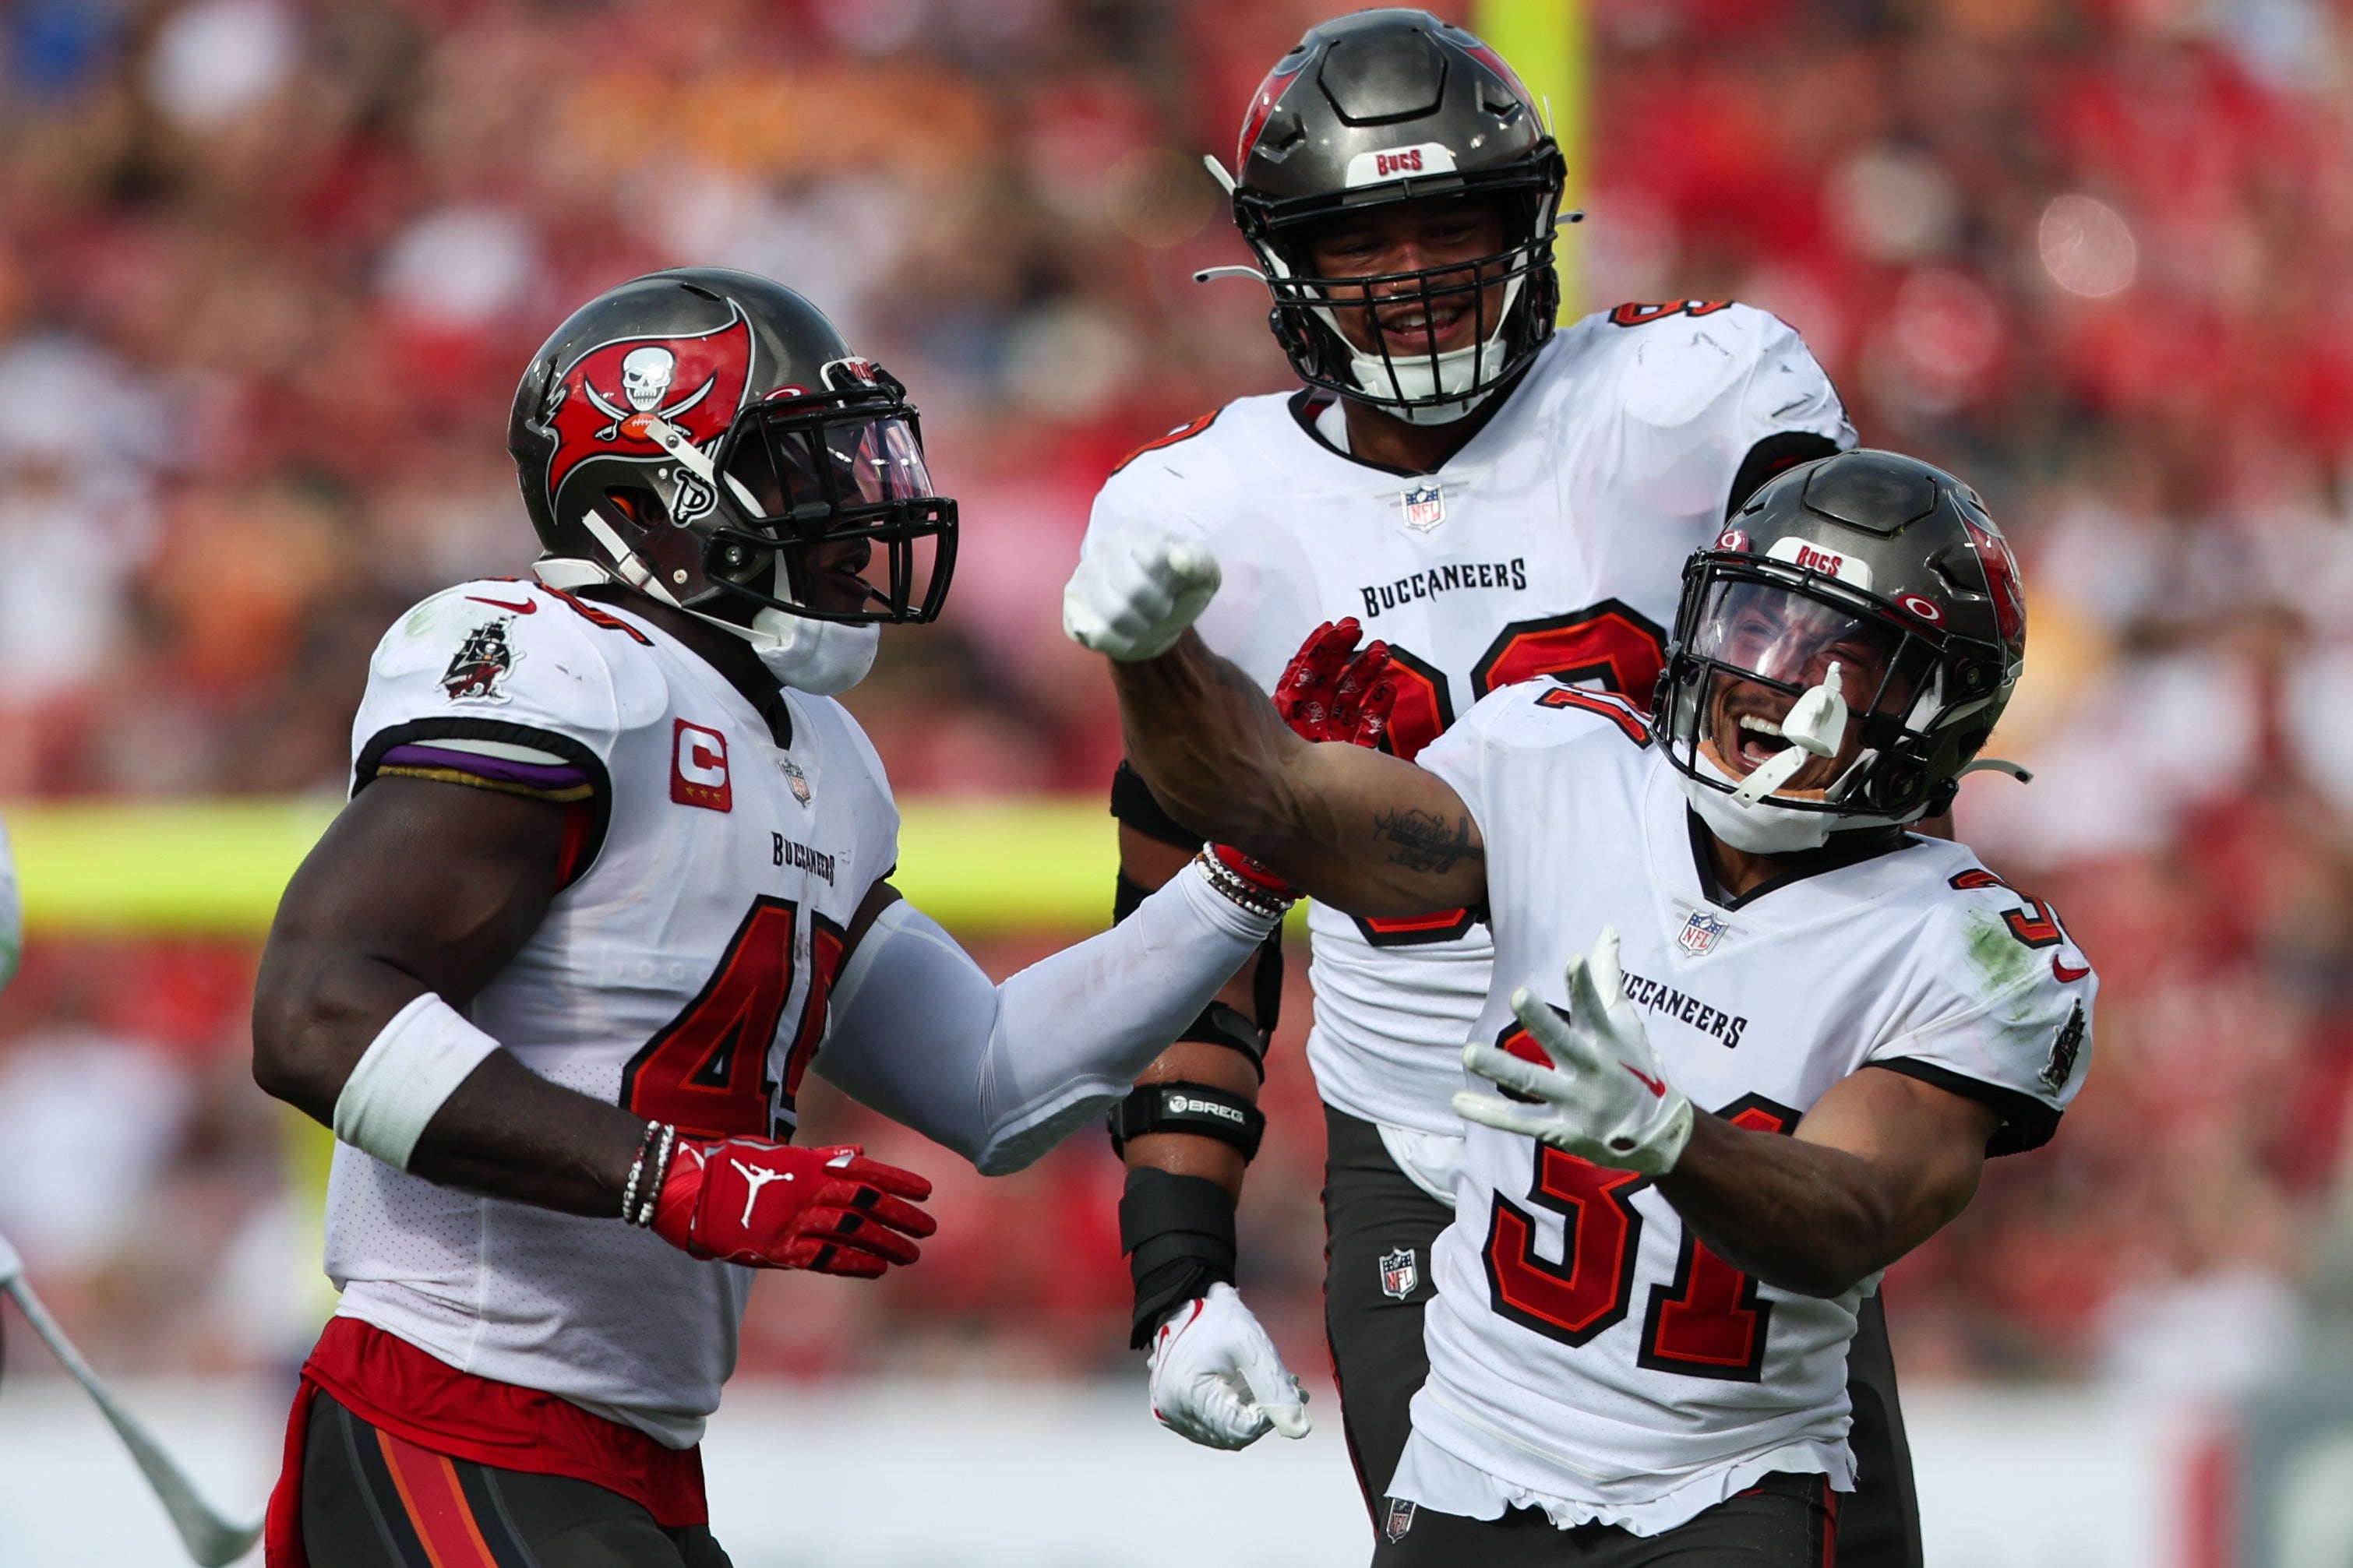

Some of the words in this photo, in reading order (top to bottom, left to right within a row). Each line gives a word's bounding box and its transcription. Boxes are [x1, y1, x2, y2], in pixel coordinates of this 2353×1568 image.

[1376, 149, 1423, 176] BUCS
[1409, 498, 1441, 523] NFL
[1795, 545, 1843, 578] BUCS
[1359, 558, 1527, 618] BUCCANEERS
[771, 830, 835, 888] BUCCANEERS
[1681, 925, 1715, 950] NFL
[1620, 968, 1748, 1049] CCANEERS
[1187, 1099, 1244, 1123] BREG
[1386, 1269, 1413, 1291] NFL
